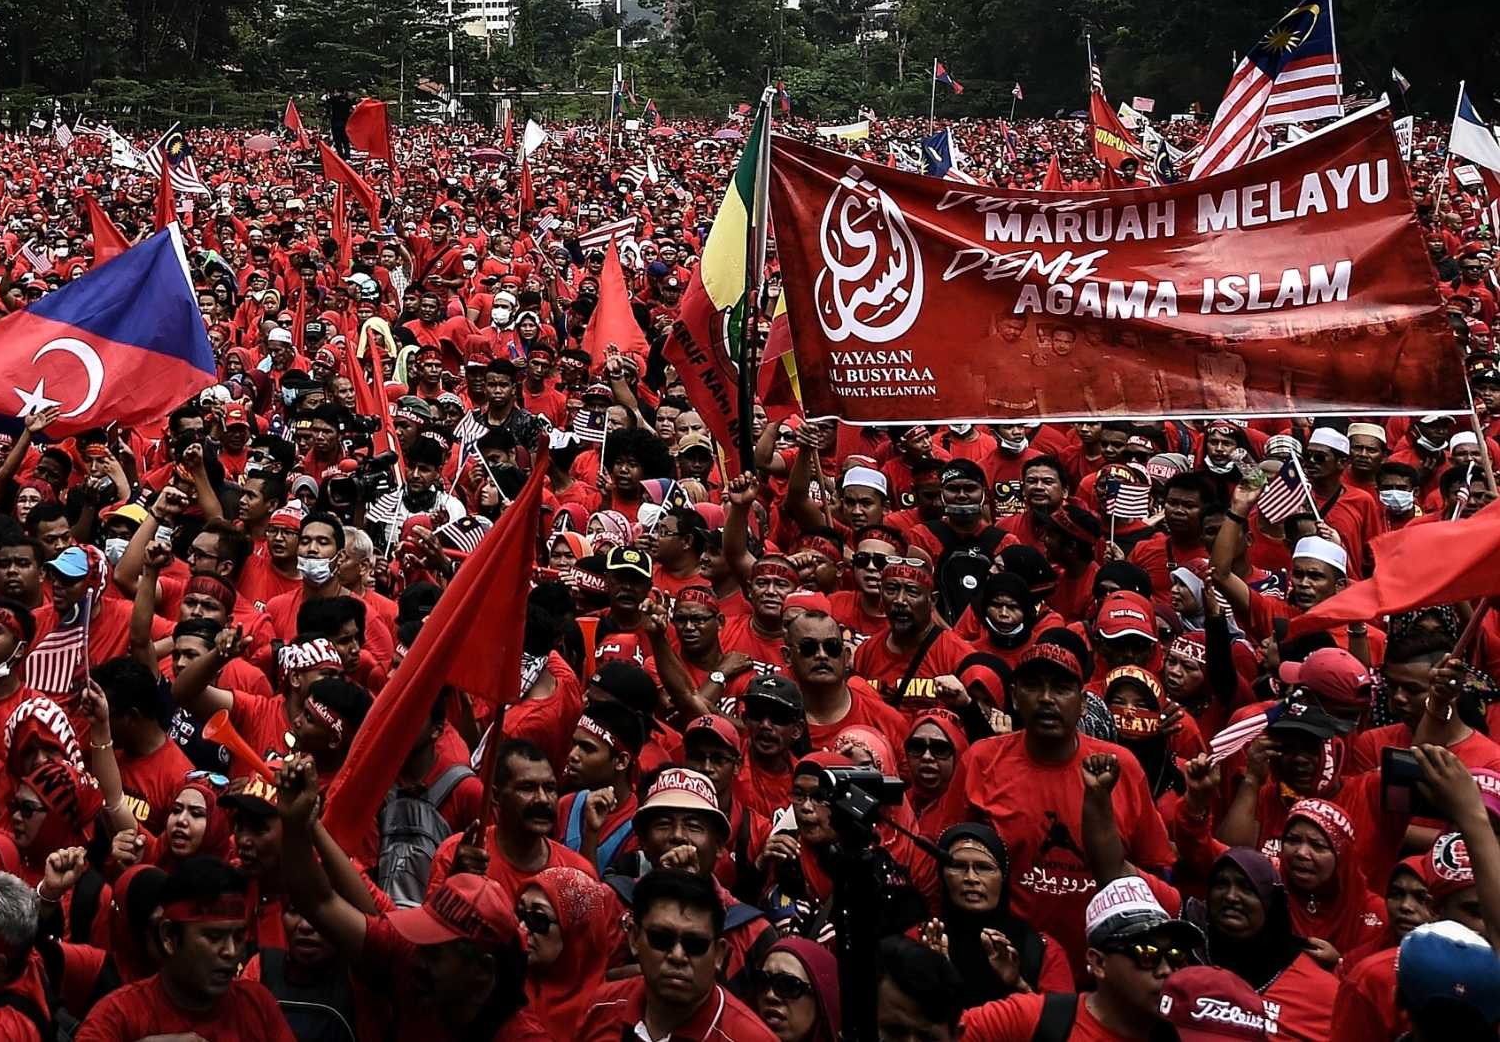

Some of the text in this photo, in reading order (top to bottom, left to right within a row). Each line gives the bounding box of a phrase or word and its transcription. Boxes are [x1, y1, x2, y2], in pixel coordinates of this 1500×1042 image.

[985, 159, 1389, 243] MARUAH MELAYU
[942, 249, 1108, 282] DEMI
[1014, 260, 1352, 319] AGAMA ISLAM
[831, 349, 912, 366] YAYASAN
[850, 367, 934, 385] BUSYRAA
[871, 384, 938, 398] KELANTAN
[1111, 715, 1159, 733] ELAY
